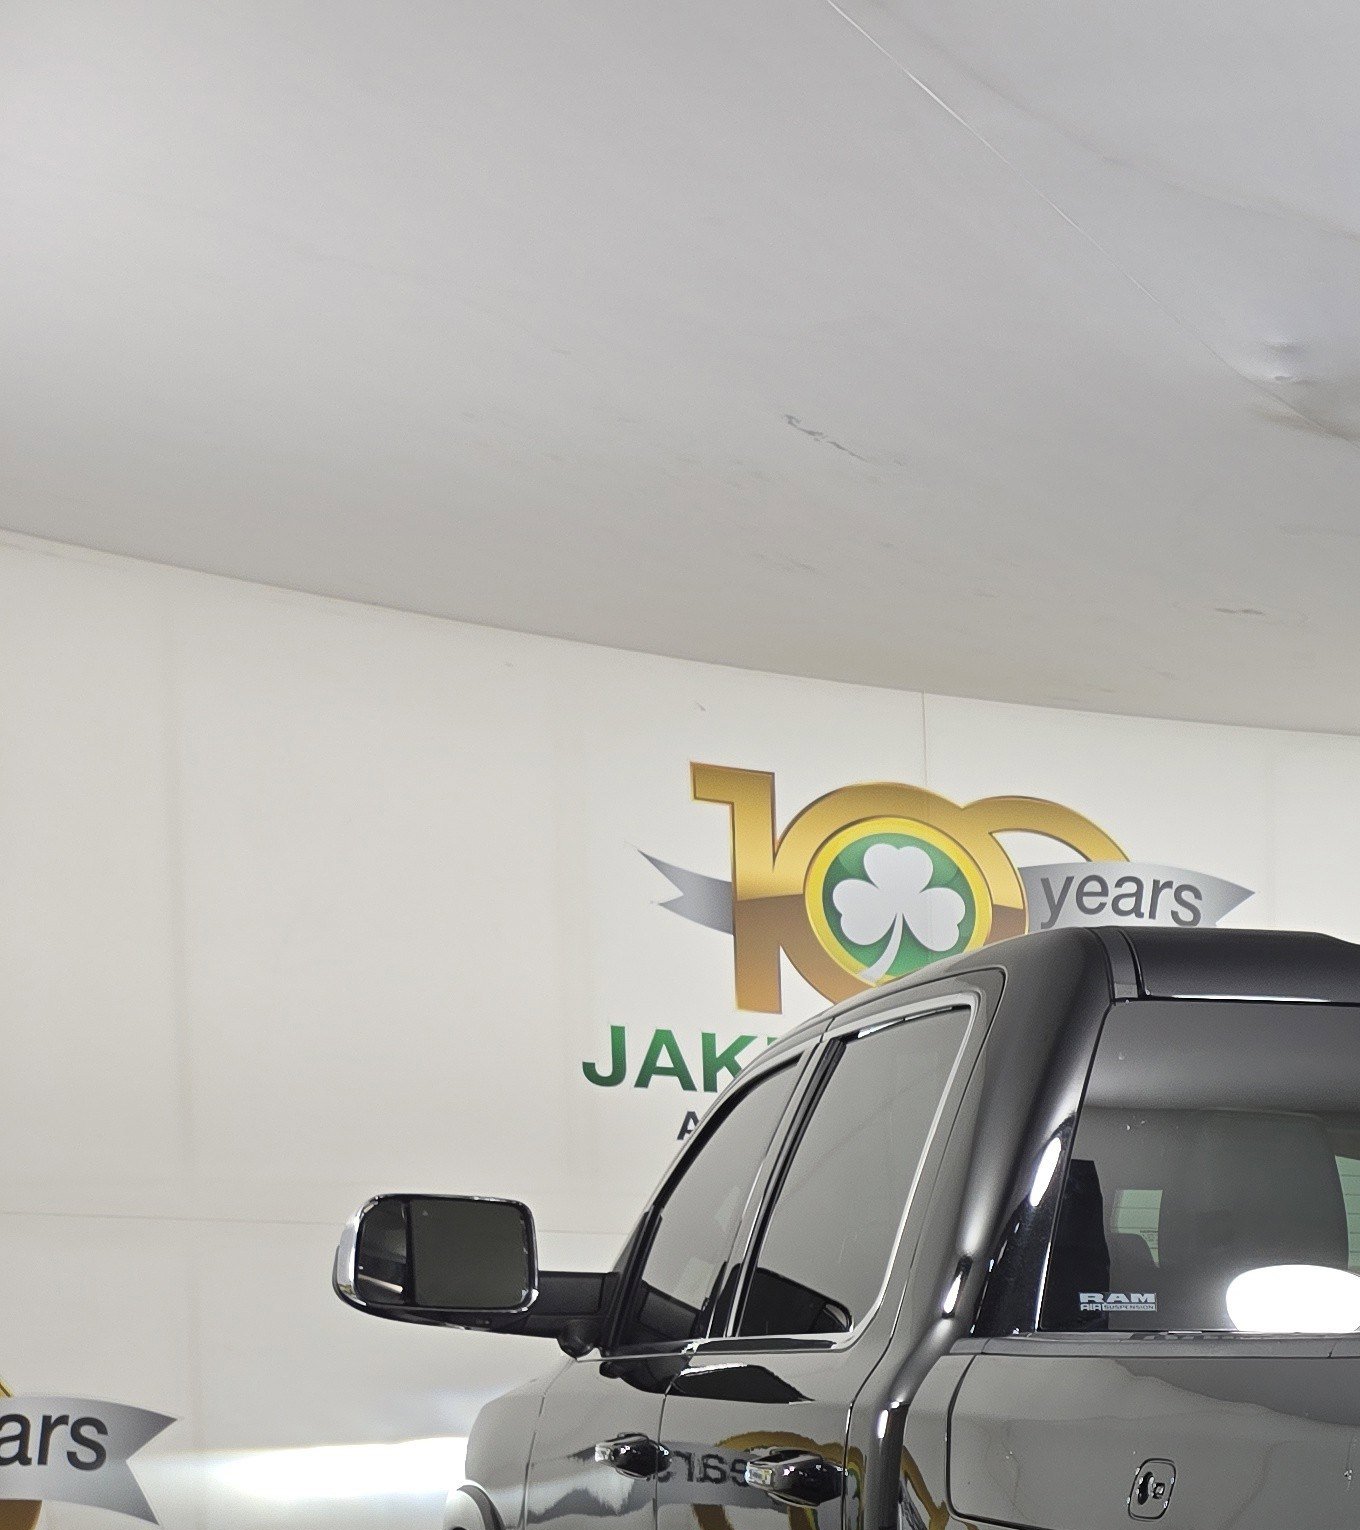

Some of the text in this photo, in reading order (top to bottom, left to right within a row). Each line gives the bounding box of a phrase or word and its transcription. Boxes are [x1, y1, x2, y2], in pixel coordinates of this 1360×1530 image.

[1040, 874, 1203, 928] years
[582, 1025, 777, 1092] JAK
[1080, 1293, 1155, 1302] RAM
[1081, 1303, 1101, 1311] AIR
